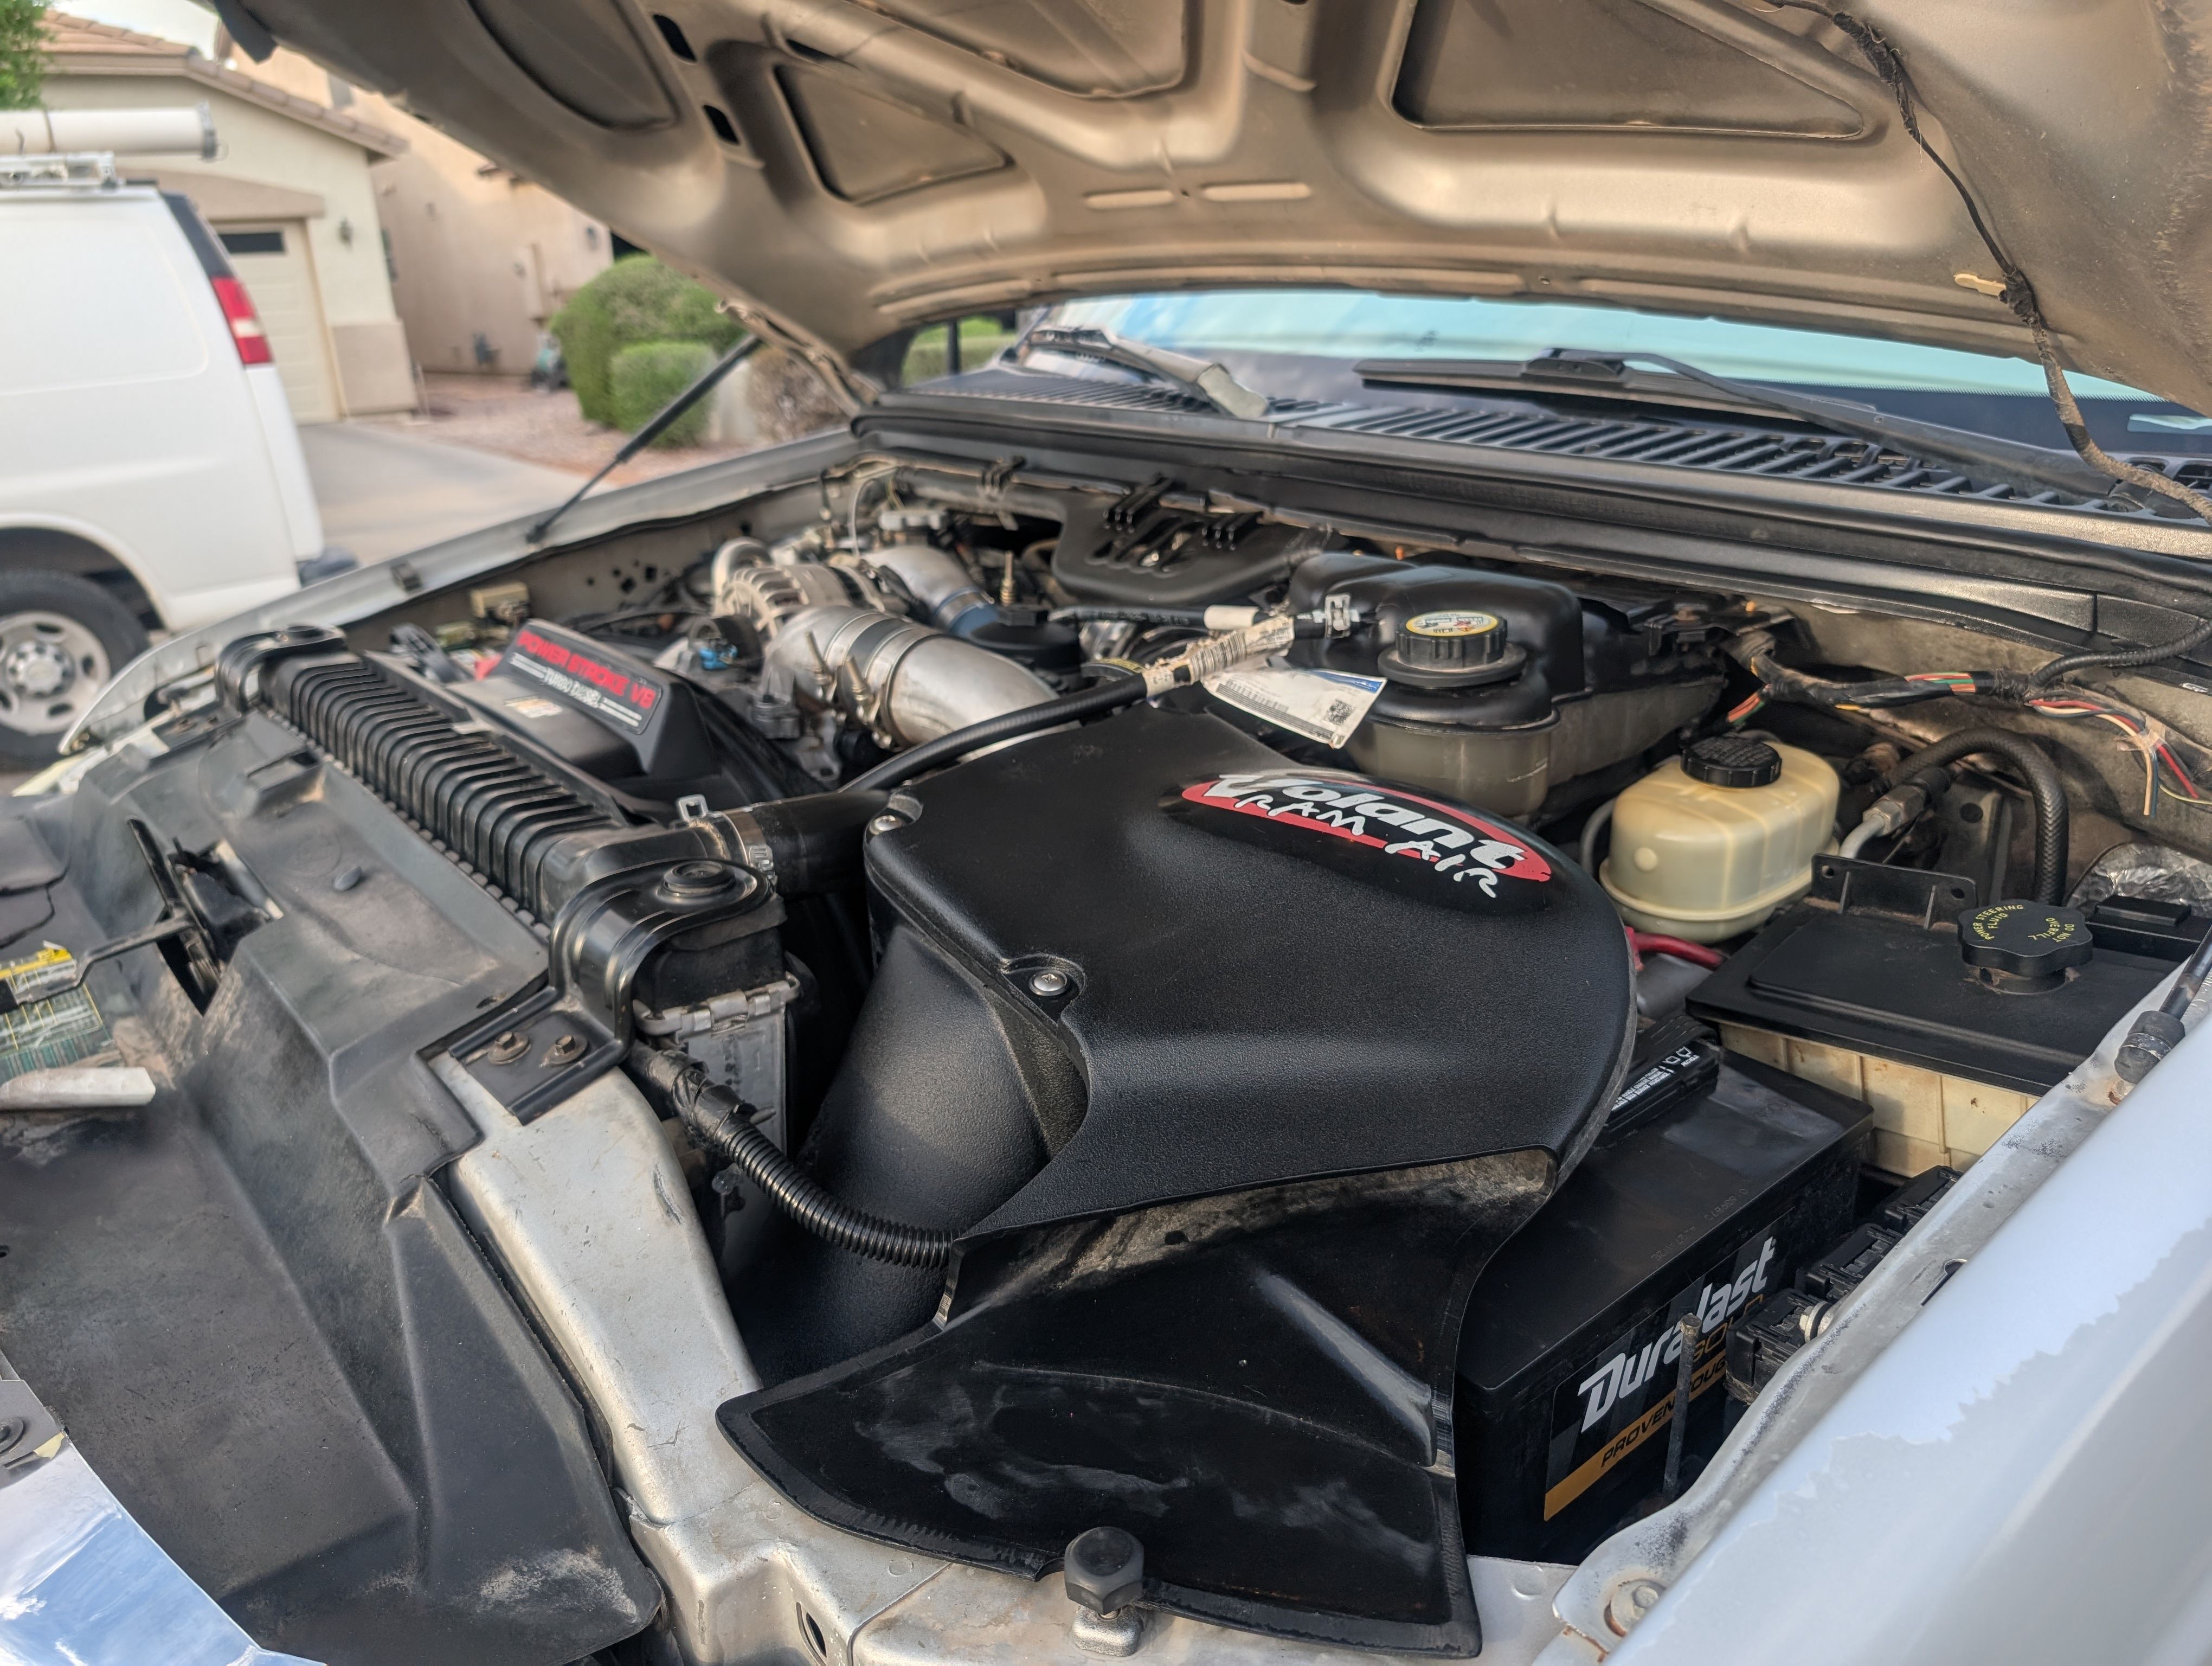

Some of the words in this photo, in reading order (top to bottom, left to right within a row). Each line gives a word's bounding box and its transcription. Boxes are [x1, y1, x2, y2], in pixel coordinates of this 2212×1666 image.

[517, 630, 570, 668] POWER
[567, 653, 631, 697] STROKE
[631, 682, 656, 709] V8
[544, 667, 573, 694] TURBO
[570, 681, 602, 709] DIESEL
[1204, 774, 1526, 869] Volant
[1234, 794, 1365, 836] RAM
[1384, 840, 1499, 898] AIR
[1975, 904, 2025, 921] STEERING
[1987, 913, 2009, 930] FLUID
[2027, 917, 2060, 940] OVERFILL
[2064, 924, 2075, 932] DO
[1972, 922, 1995, 940] POWER
[2052, 932, 2071, 943] NOT
[1577, 1236, 1776, 1433] Duralast
[1600, 1395, 1676, 1468] PROVEN
